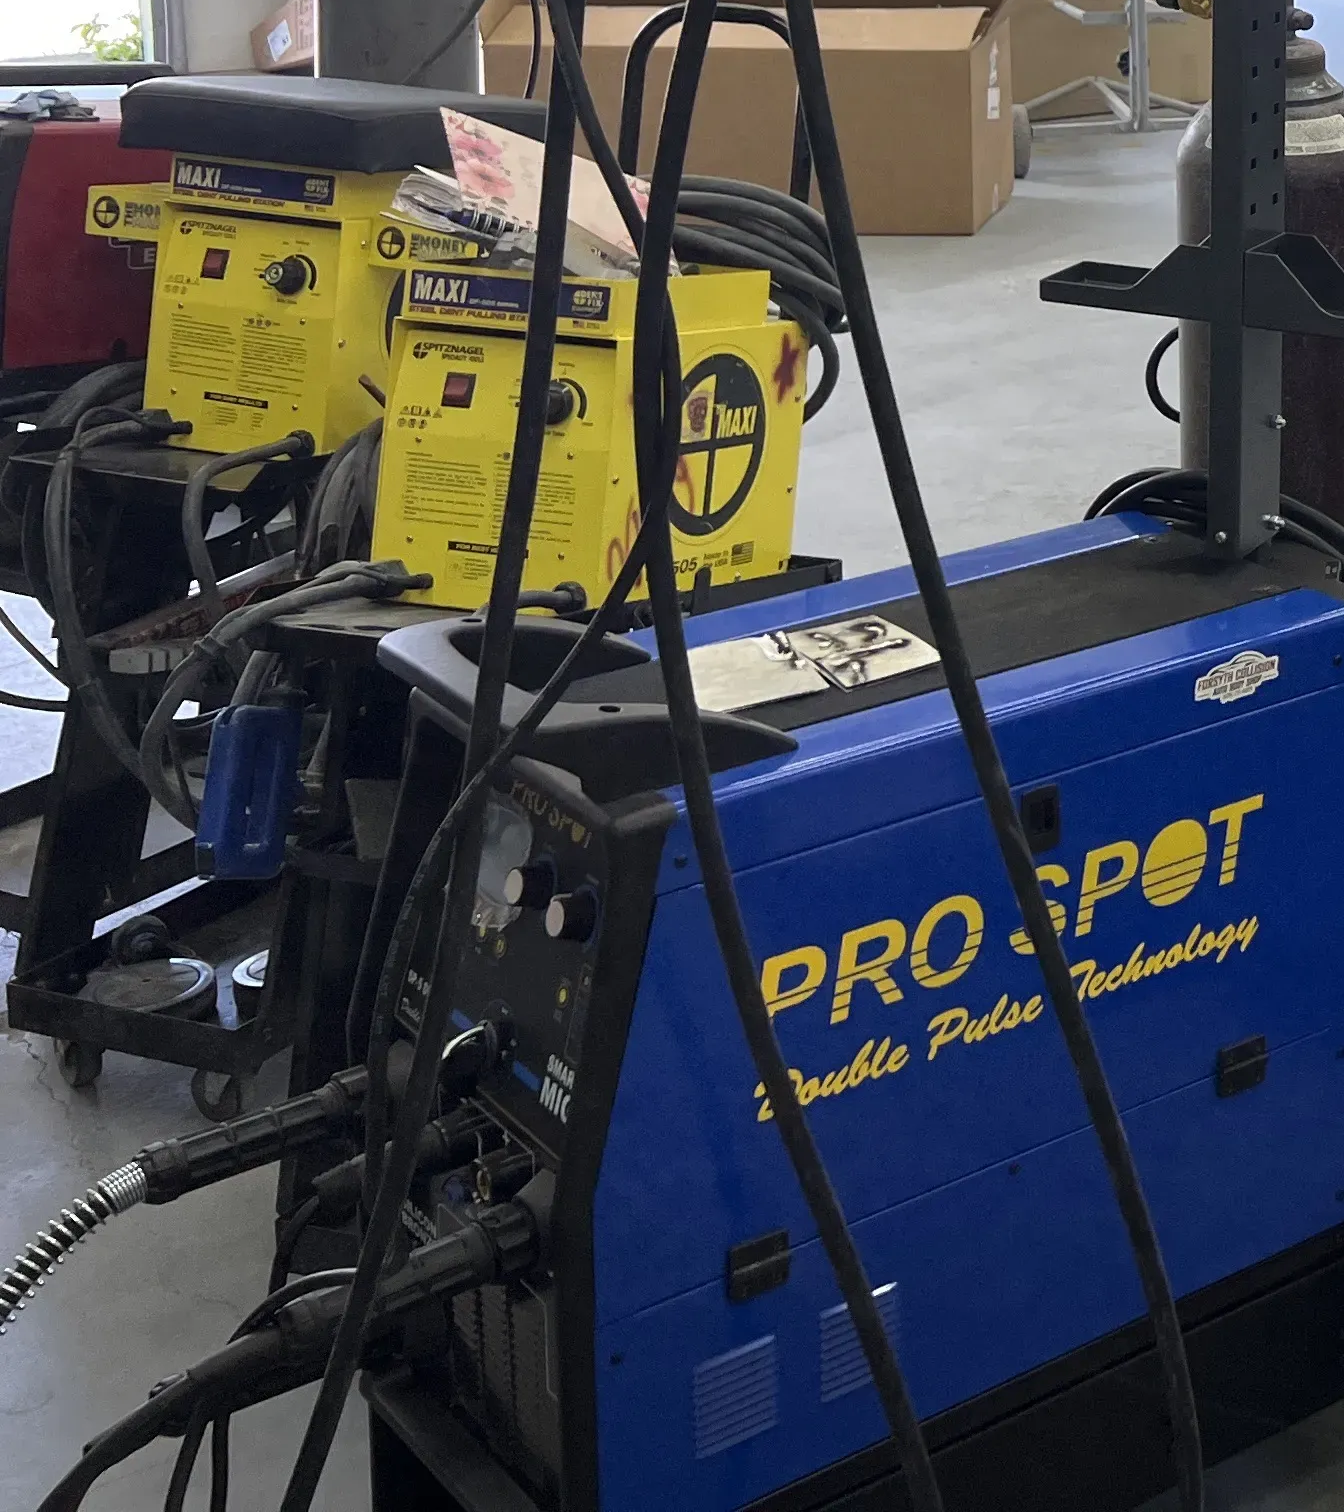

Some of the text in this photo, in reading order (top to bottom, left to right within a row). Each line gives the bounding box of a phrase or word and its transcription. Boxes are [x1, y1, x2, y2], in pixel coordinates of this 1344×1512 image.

[177, 161, 222, 189] MAXI
[418, 236, 468, 253] MONEY
[414, 273, 470, 304] MAXI
[422, 342, 483, 356] SPITZNAGEL
[716, 405, 758, 439] MAXI
[760, 793, 1265, 1027] PRO SPOT
[926, 991, 1045, 1061] Pulse
[1068, 915, 1260, 1004] Technology
